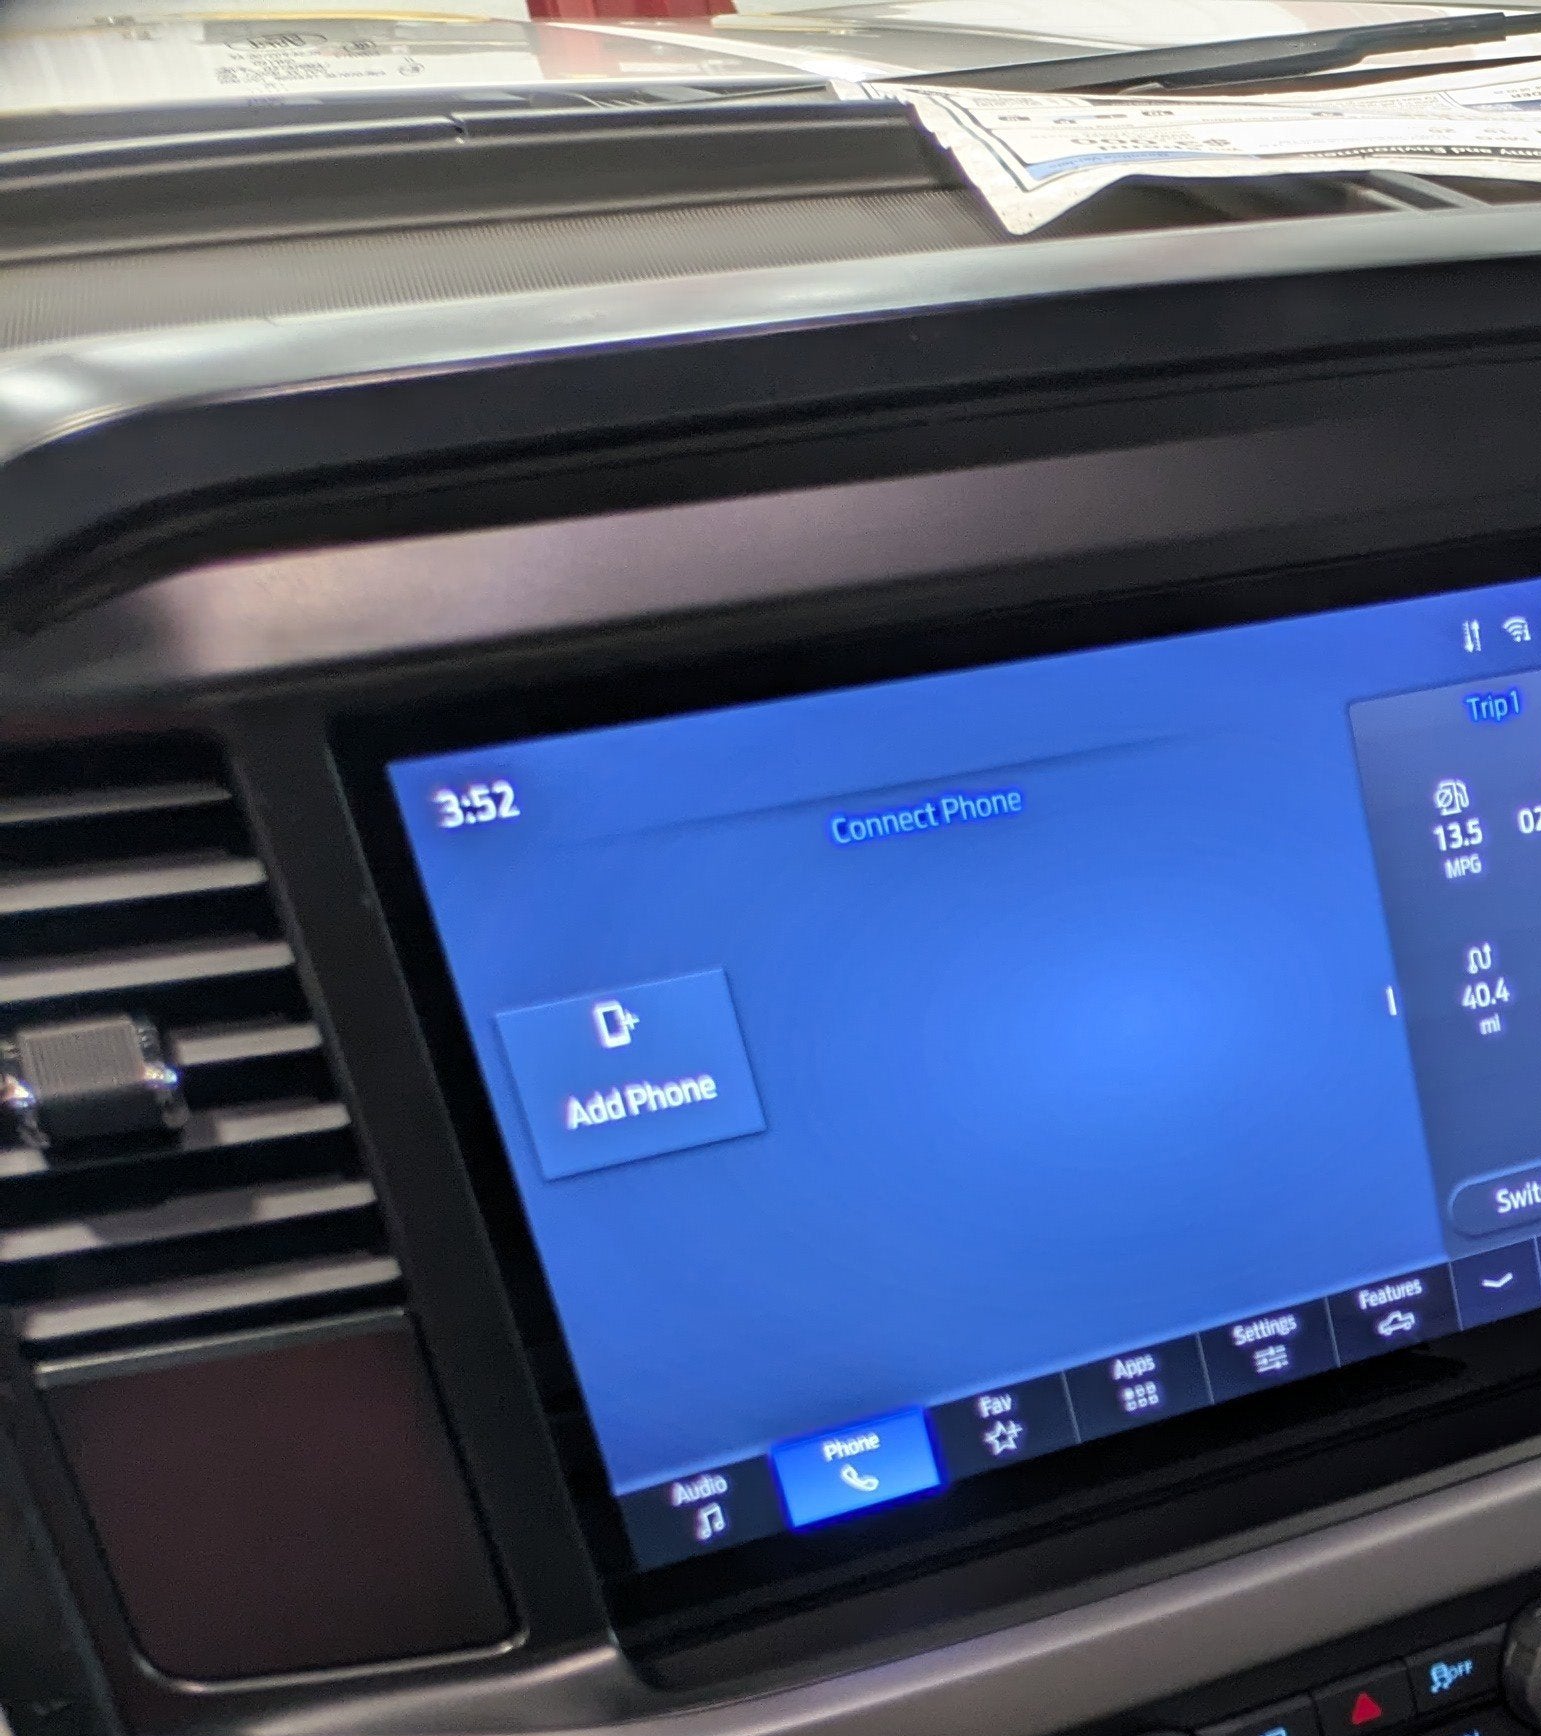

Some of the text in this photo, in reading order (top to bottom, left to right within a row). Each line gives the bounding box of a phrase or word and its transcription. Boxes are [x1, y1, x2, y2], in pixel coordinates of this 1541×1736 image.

[1466, 691, 1521, 722] Trip 1
[433, 779, 520, 828] 3:52
[831, 791, 1022, 844] Connect Phone
[1433, 818, 1483, 851] 13.5
[1444, 854, 1482, 879] MPG
[1461, 977, 1511, 1011] 40.4
[1480, 1014, 1502, 1035] mi
[566, 1072, 719, 1131] Add Phone
[1358, 1277, 1423, 1310] Features
[1231, 1312, 1298, 1347] Settings
[1112, 1353, 1156, 1381] Apps
[978, 1394, 1013, 1420] Fav
[822, 1431, 881, 1464] Phone
[670, 1474, 729, 1507] Audio
[1449, 1658, 1473, 1682] OFF
